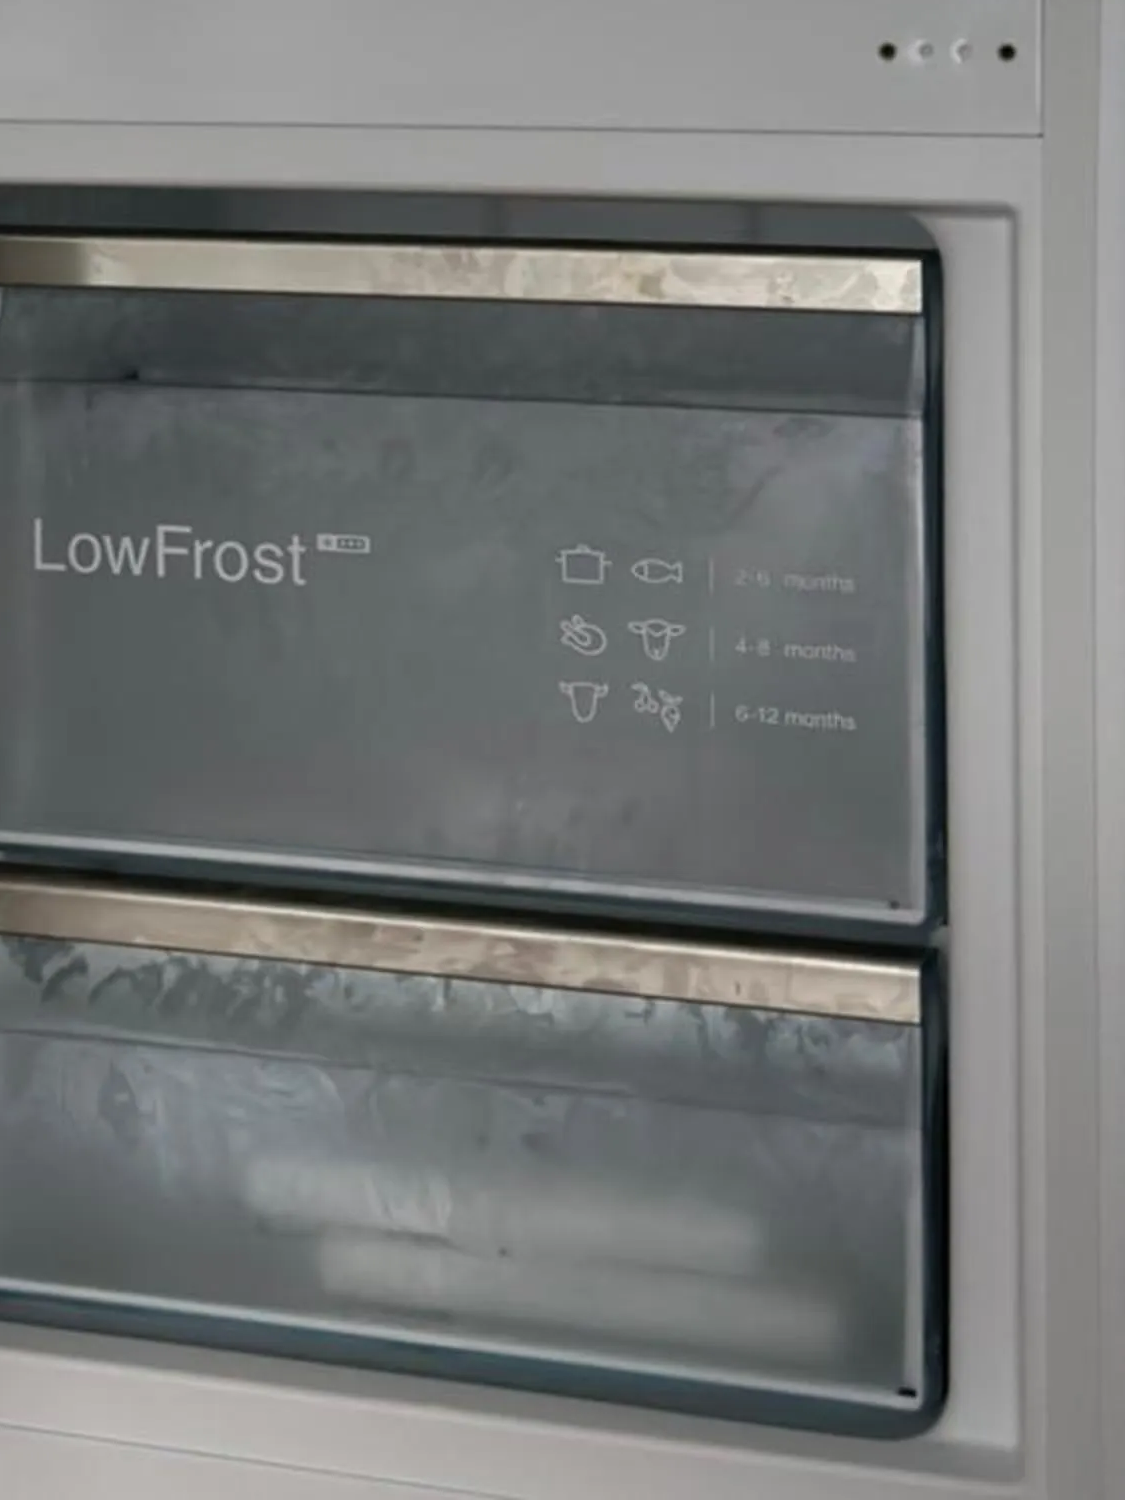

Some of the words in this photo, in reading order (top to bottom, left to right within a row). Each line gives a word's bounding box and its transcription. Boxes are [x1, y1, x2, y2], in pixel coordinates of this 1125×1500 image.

[33, 517, 307, 586] LowFrost
[783, 572, 856, 595] months
[734, 634, 771, 657] 4-8
[783, 642, 858, 663] months
[734, 704, 780, 725] 6-12
[783, 709, 858, 732] months
